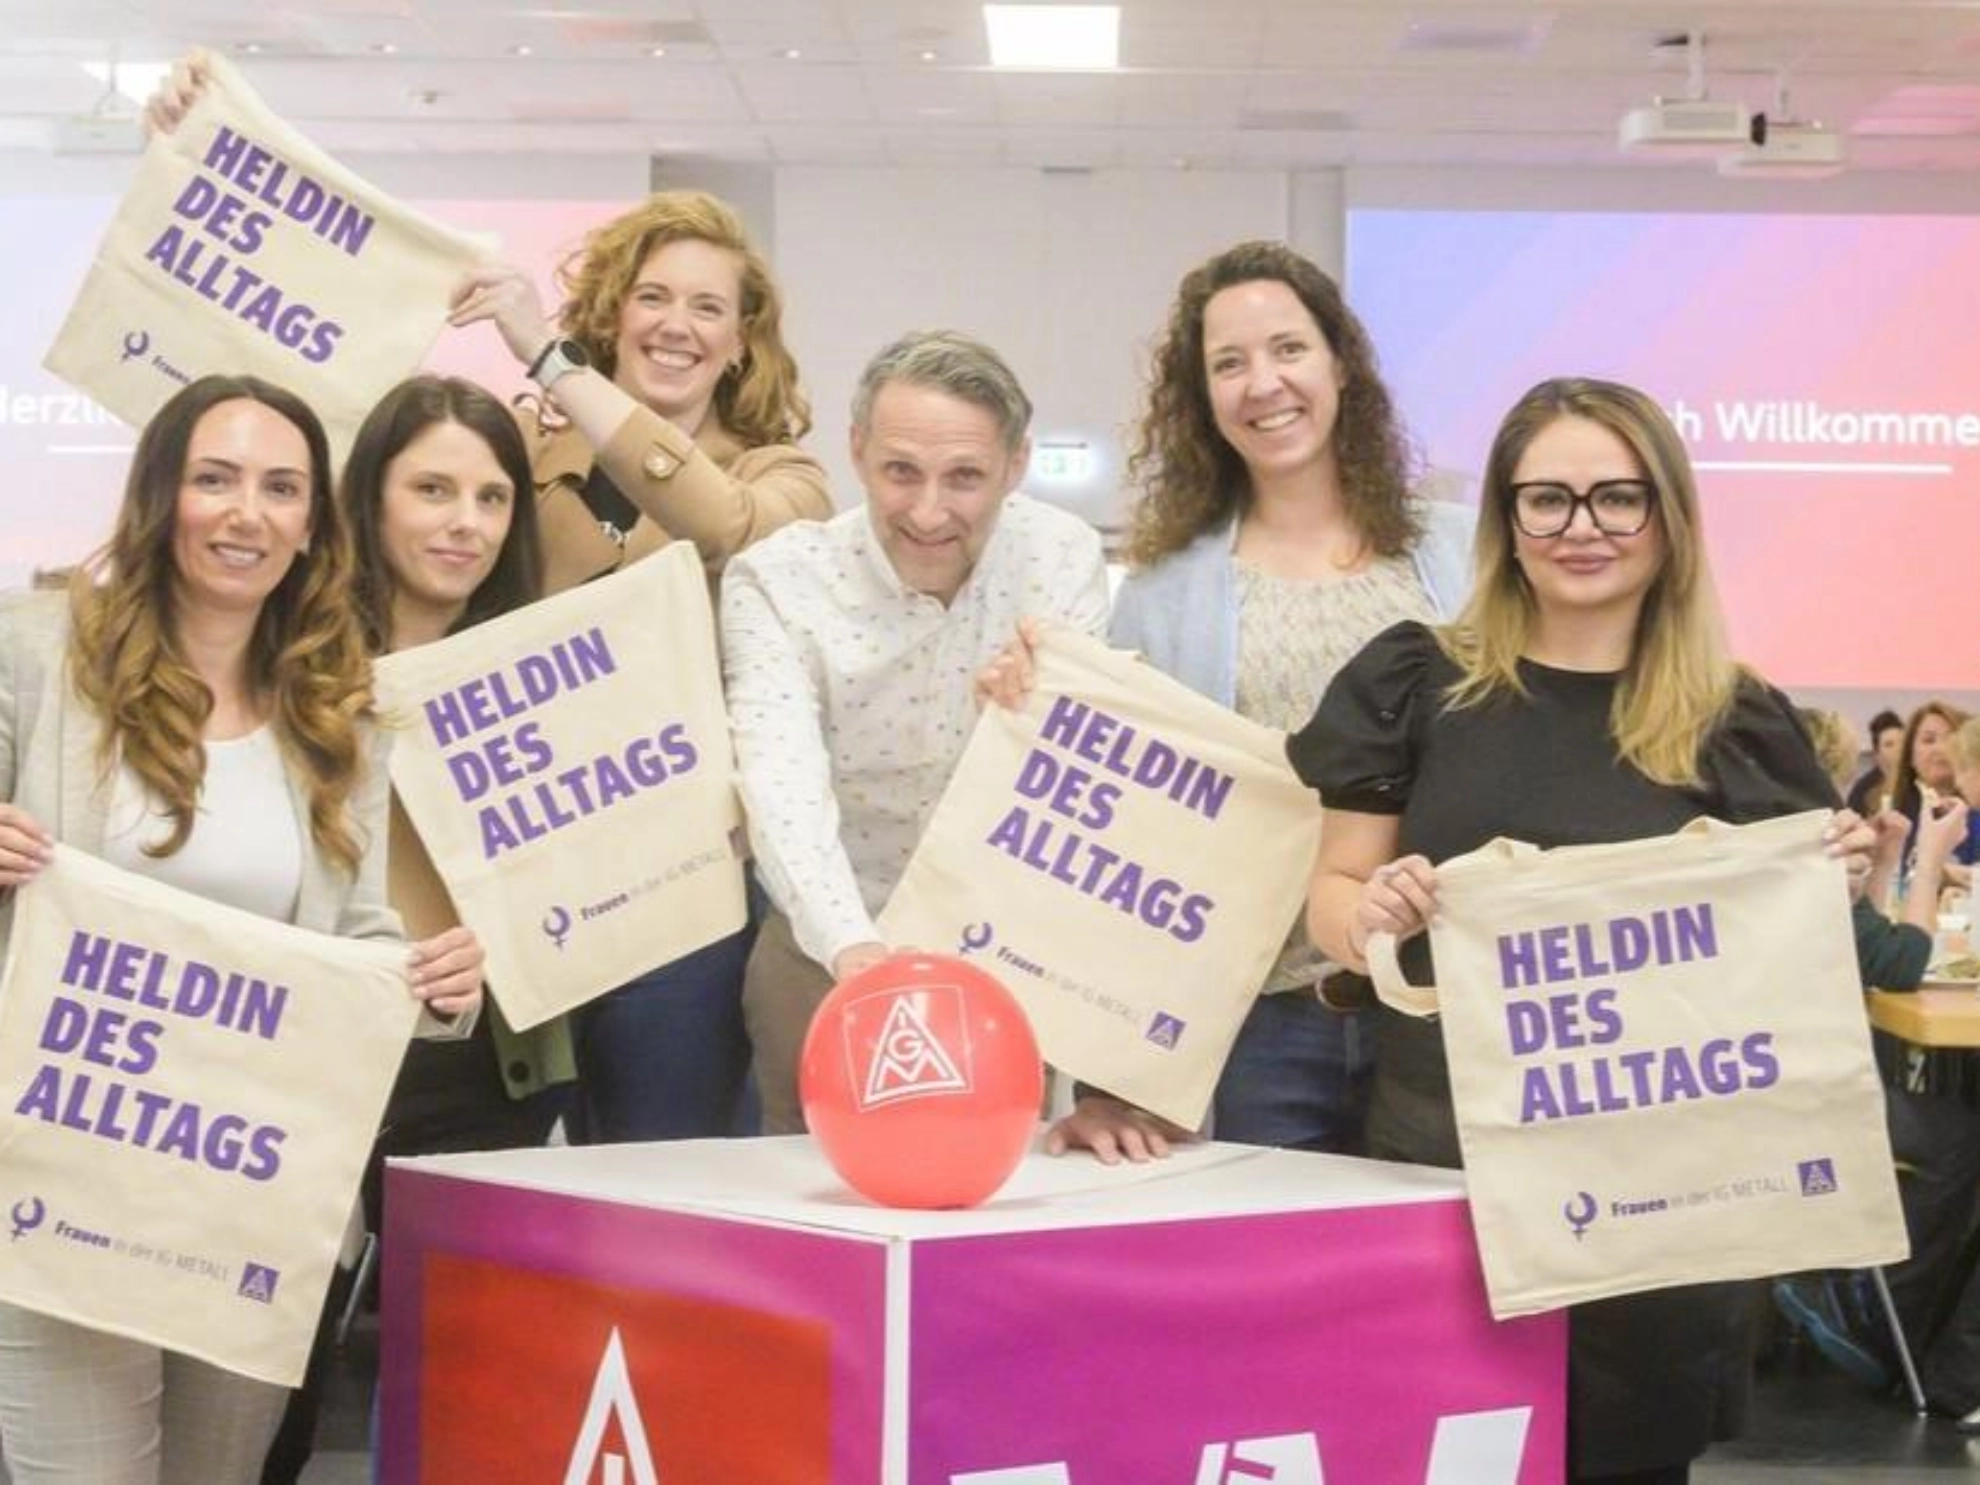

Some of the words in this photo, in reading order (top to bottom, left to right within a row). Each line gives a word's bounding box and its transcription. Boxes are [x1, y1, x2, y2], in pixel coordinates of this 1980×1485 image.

[173, 175, 274, 255] DES
[205, 126, 374, 256] HELDIN
[147, 225, 342, 363] ALLTAGS
[425, 628, 616, 748] HELDIN
[446, 723, 554, 803] DES
[479, 723, 698, 858] ALLTAGS
[1014, 748, 1122, 830] DES
[1040, 696, 1232, 820] HELDIN
[986, 806, 1214, 943] ALLTAGS
[61, 931, 288, 1040] HELDIN
[1498, 903, 1718, 989] HELDIN
[39, 996, 162, 1076] DES
[1505, 988, 1624, 1056] DES
[15, 1065, 285, 1182] ALLTAGS
[1520, 1031, 1780, 1124] ALLTAGS
[1611, 1199, 1669, 1217] Frauen
